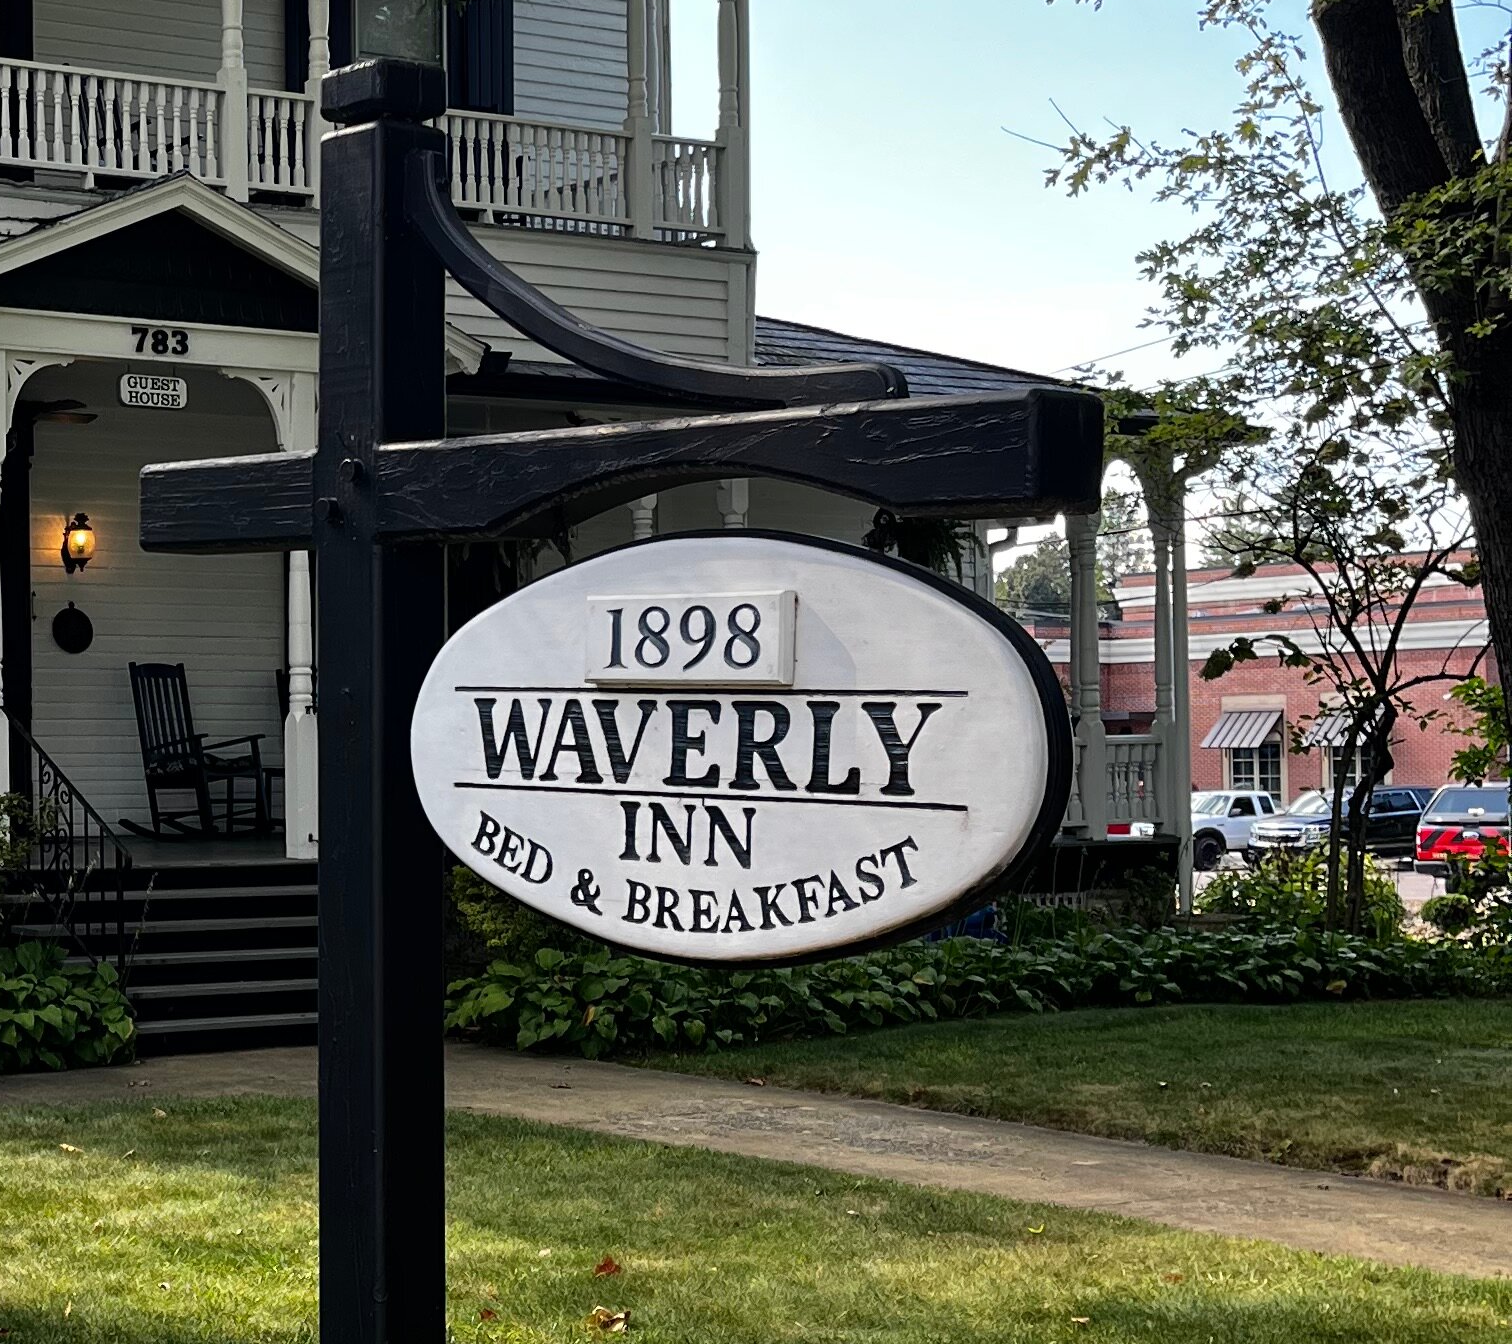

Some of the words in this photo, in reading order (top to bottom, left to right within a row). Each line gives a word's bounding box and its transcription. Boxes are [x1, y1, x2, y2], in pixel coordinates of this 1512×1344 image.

[131, 326, 189, 355] 783
[127, 375, 180, 392] GUEST
[127, 390, 181, 407] HOUSE
[605, 602, 762, 673] 1898
[473, 697, 943, 797] WAVERLY
[618, 800, 757, 870] INN
[470, 810, 554, 887] BED
[570, 868, 603, 917] &
[621, 835, 919, 935] BREAKFAST
